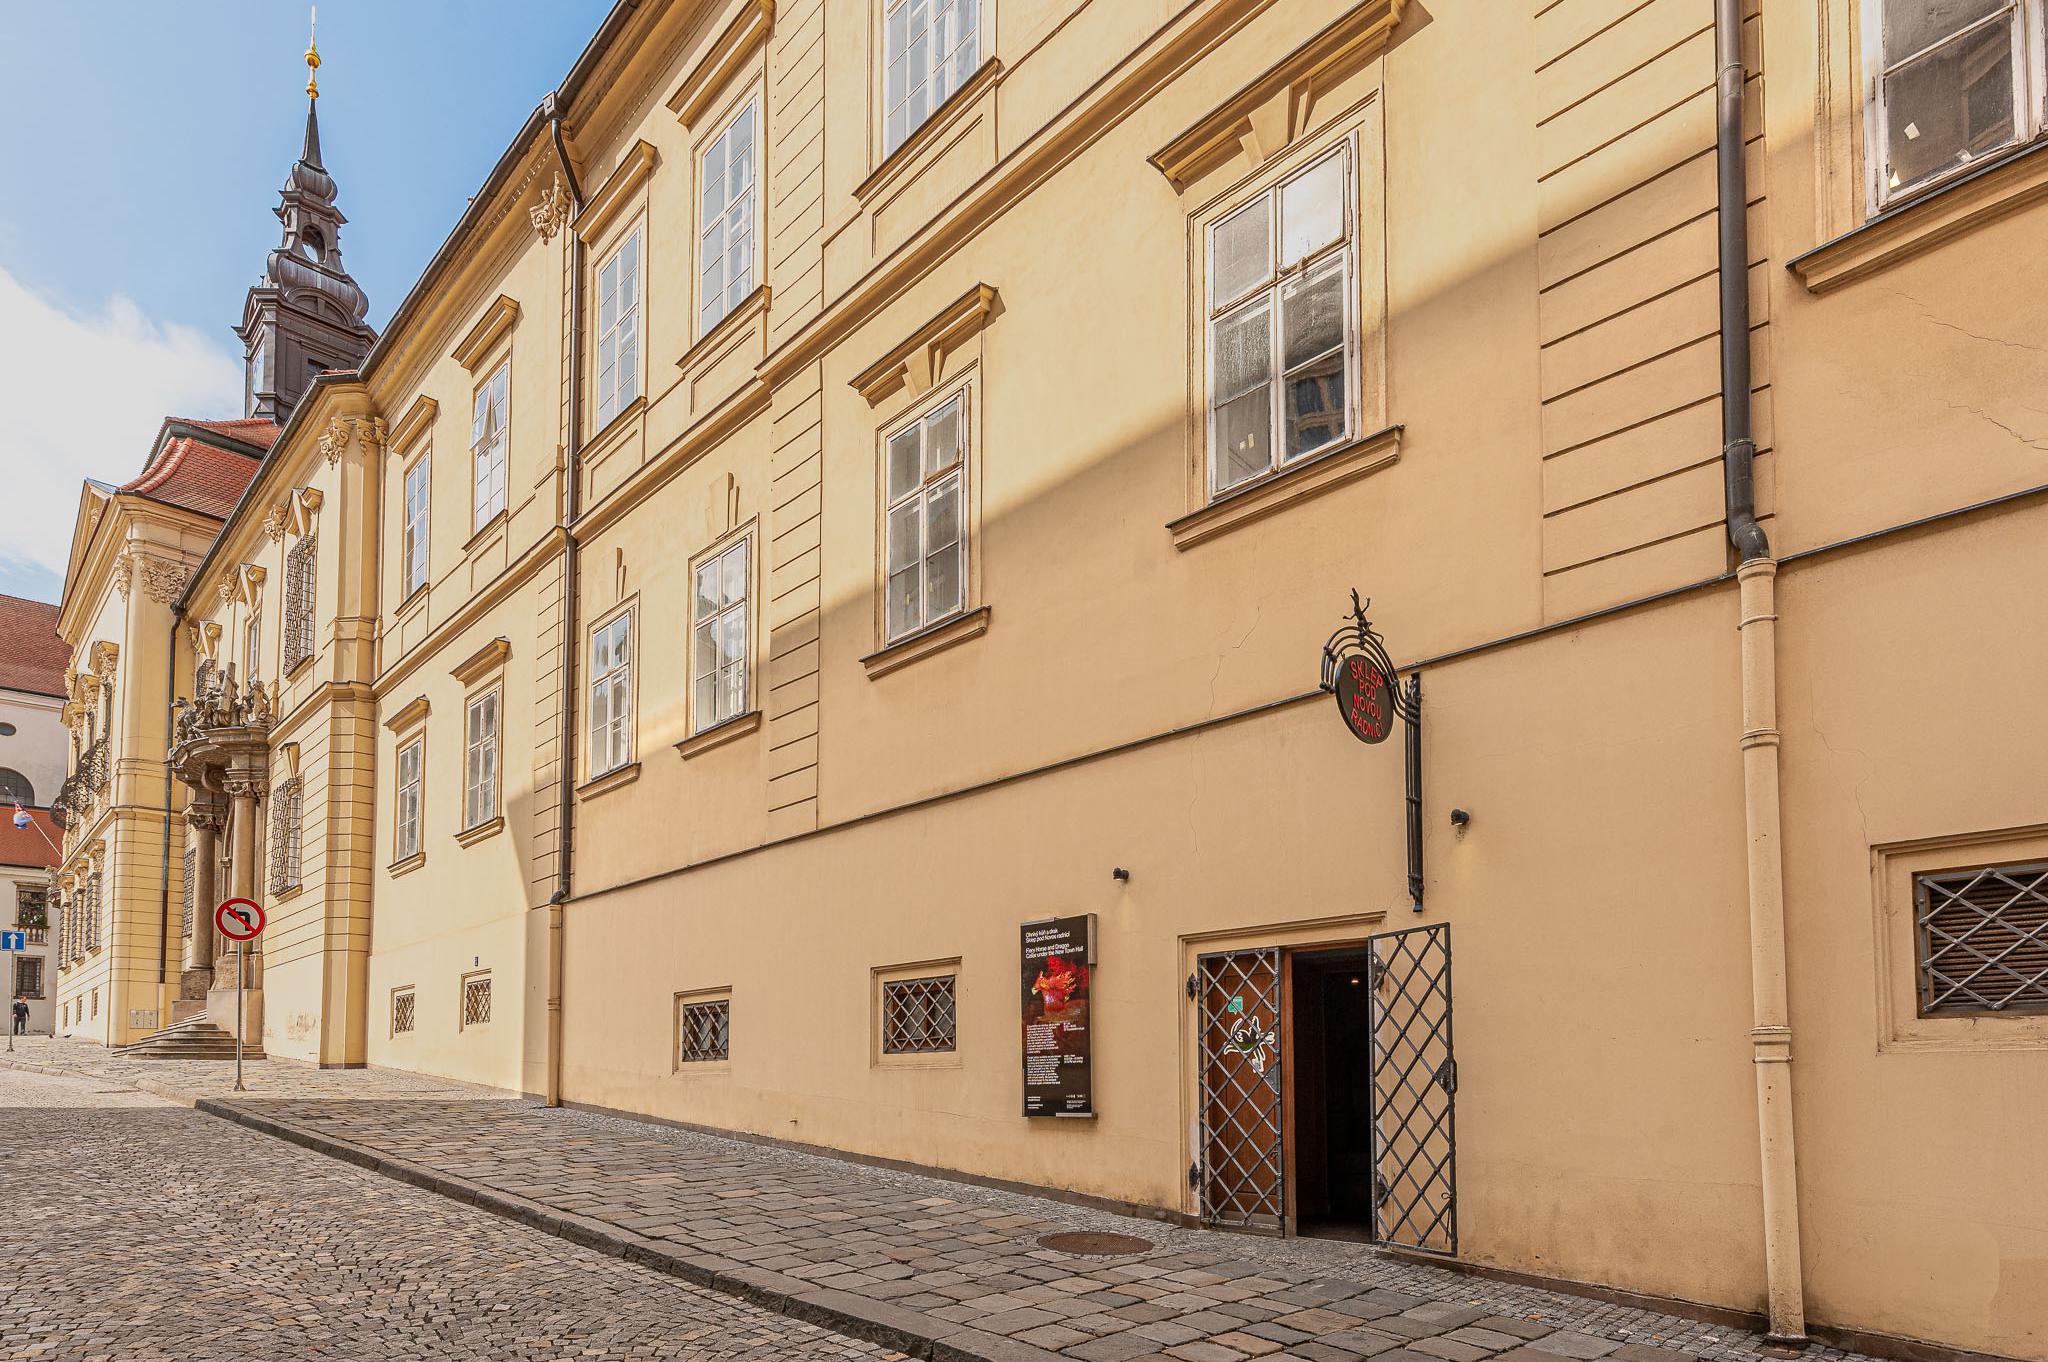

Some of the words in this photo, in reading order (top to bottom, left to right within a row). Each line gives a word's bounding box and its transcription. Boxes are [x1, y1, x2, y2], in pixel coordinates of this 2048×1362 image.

[1350, 660, 1383, 688] SKLEP
[1359, 679, 1376, 701] POD
[1353, 694, 1382, 720] NOVOU
